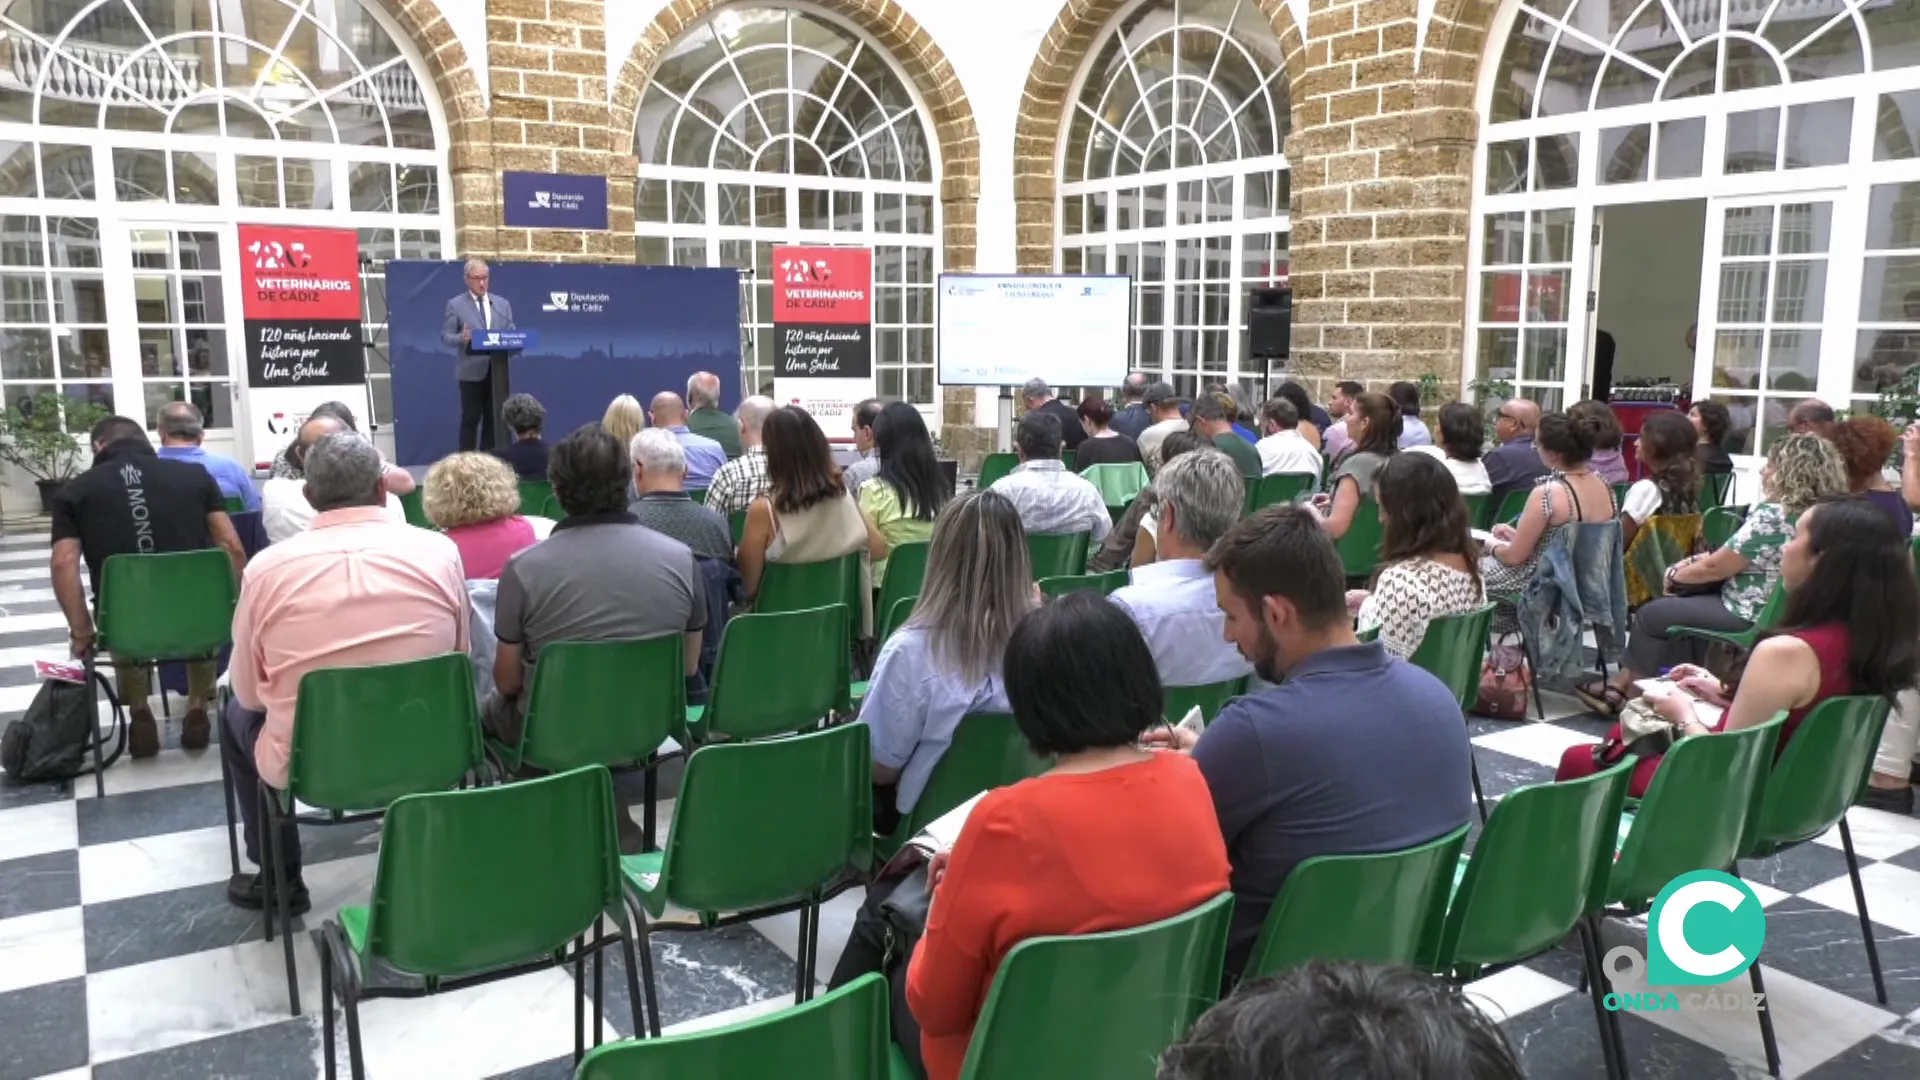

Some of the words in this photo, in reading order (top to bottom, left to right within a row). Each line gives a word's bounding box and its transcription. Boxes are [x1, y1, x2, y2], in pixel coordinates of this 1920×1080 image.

[256, 278, 351, 290] VETERINARIOS
[258, 291, 276, 302] DE
[785, 289, 864, 300] VETERINARIOS
[786, 300, 800, 309] DE
[260, 327, 282, 342] 120
[284, 329, 306, 343] años
[307, 327, 352, 342] haciendo
[785, 329, 804, 341] 120
[824, 329, 861, 341] haciendo
[261, 345, 300, 360] historia
[300, 348, 319, 362] por
[785, 343, 817, 356] historia
[817, 346, 833, 358] por
[264, 363, 290, 379] Una
[785, 357, 808, 372] Una
